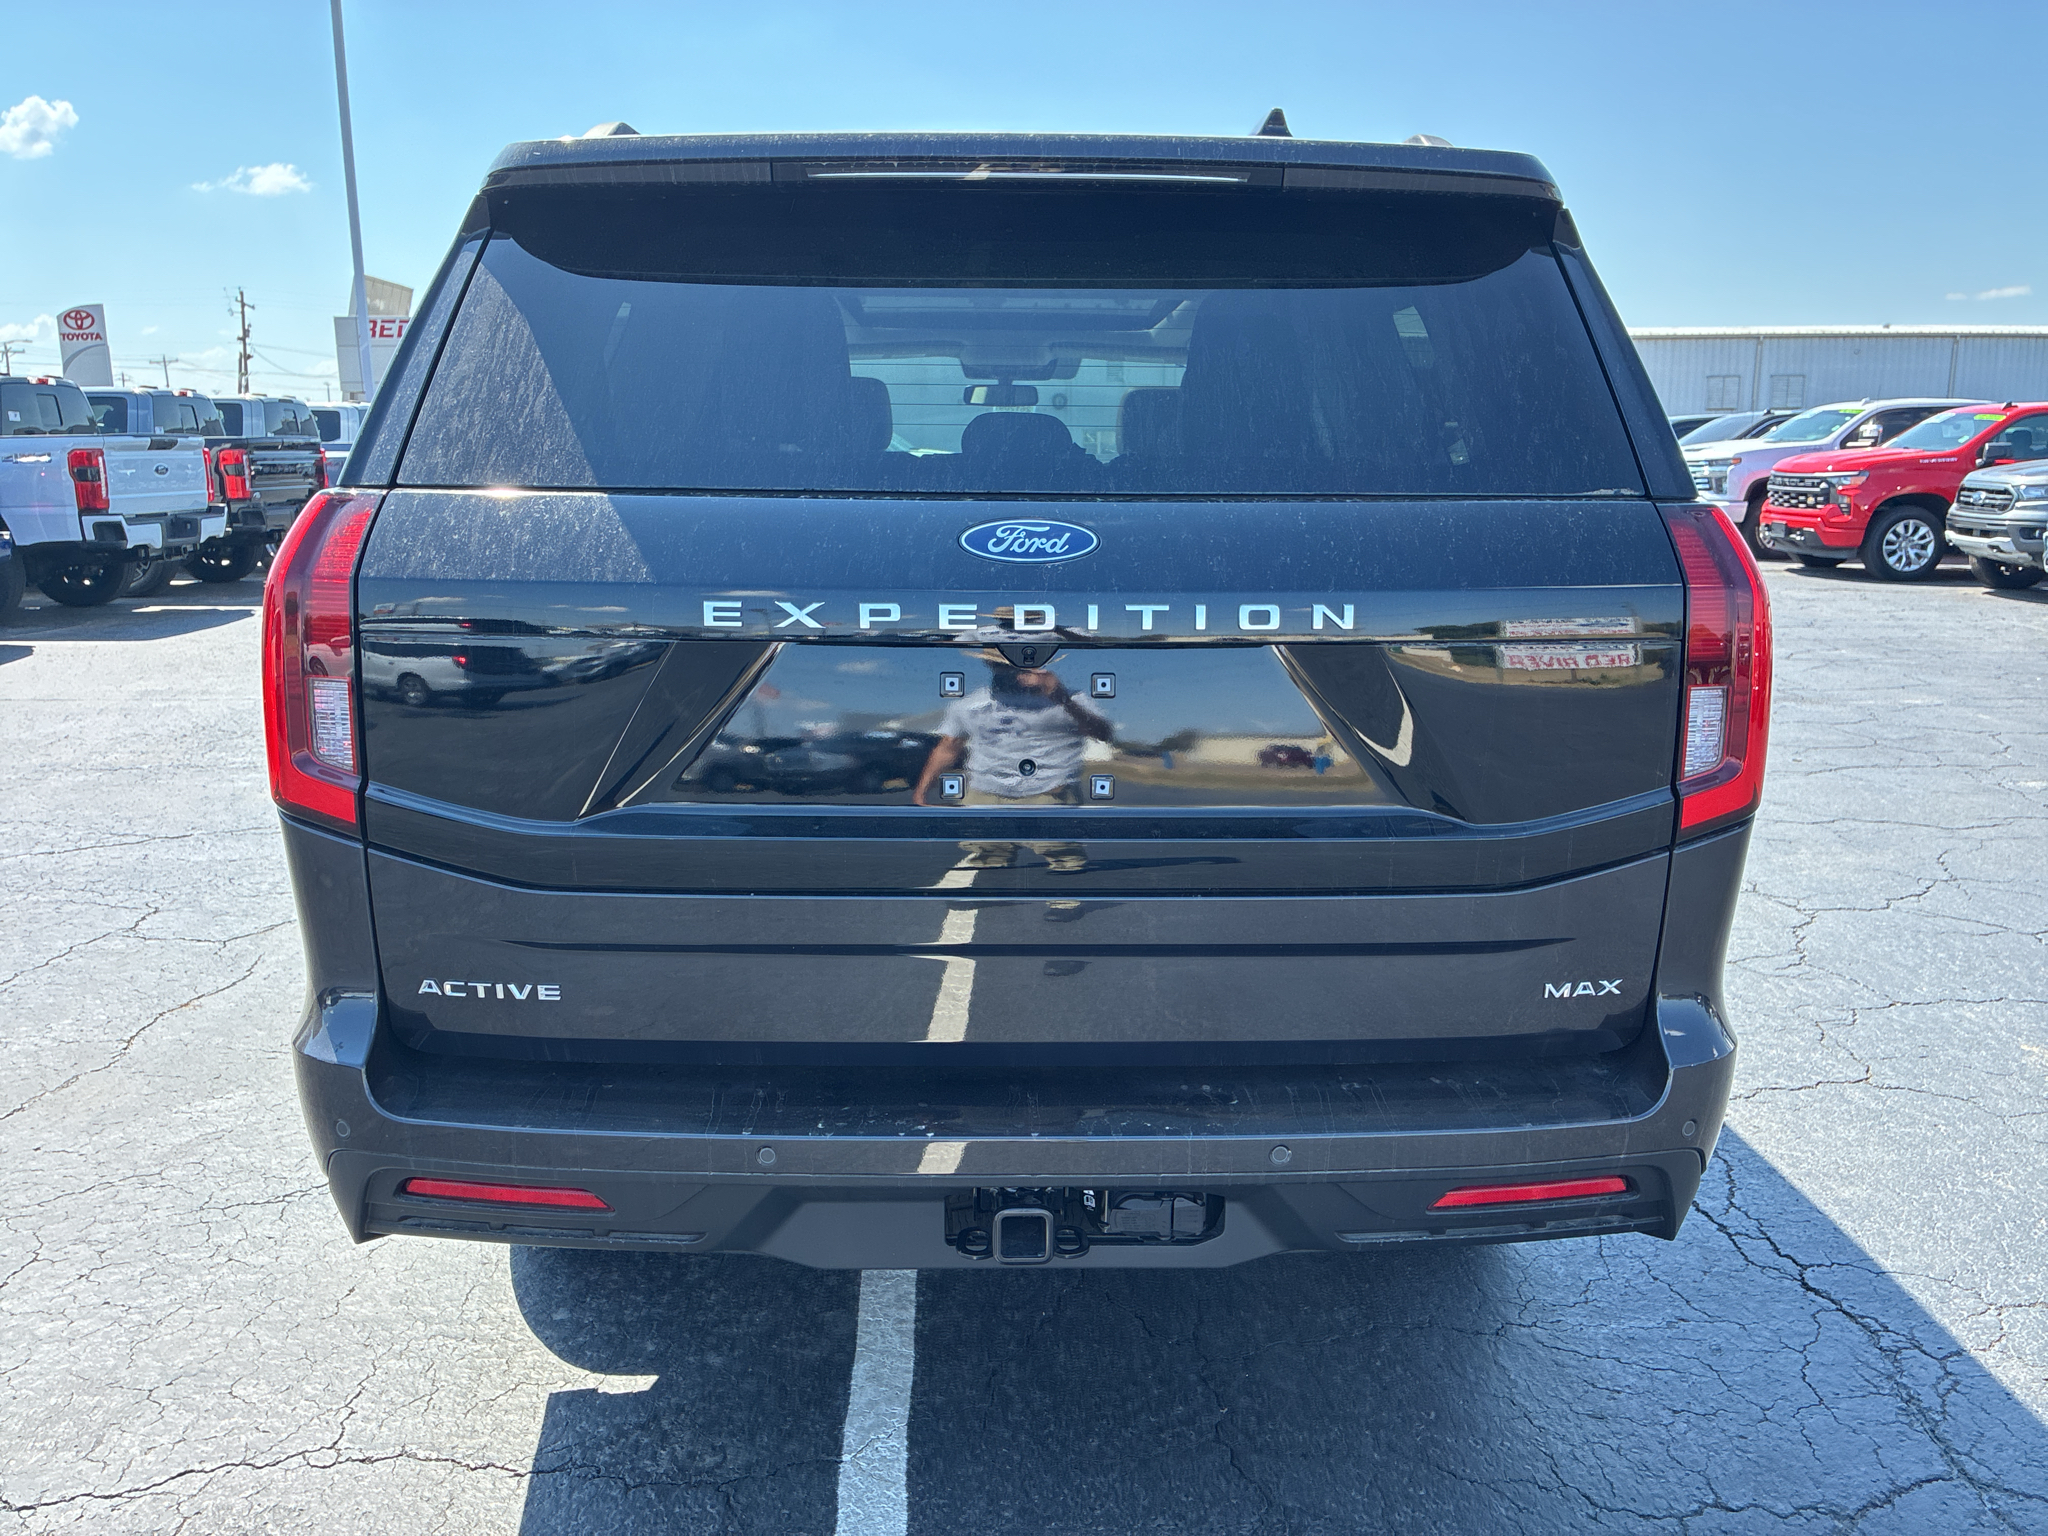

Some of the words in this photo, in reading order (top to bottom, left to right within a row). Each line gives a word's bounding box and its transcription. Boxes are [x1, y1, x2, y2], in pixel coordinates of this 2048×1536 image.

[60, 332, 103, 342] TOYOTA
[987, 524, 1072, 554] Ford
[703, 600, 1355, 631] EXPEDITION
[418, 979, 562, 1001] ACTIVE
[1543, 979, 1624, 999] MAX
